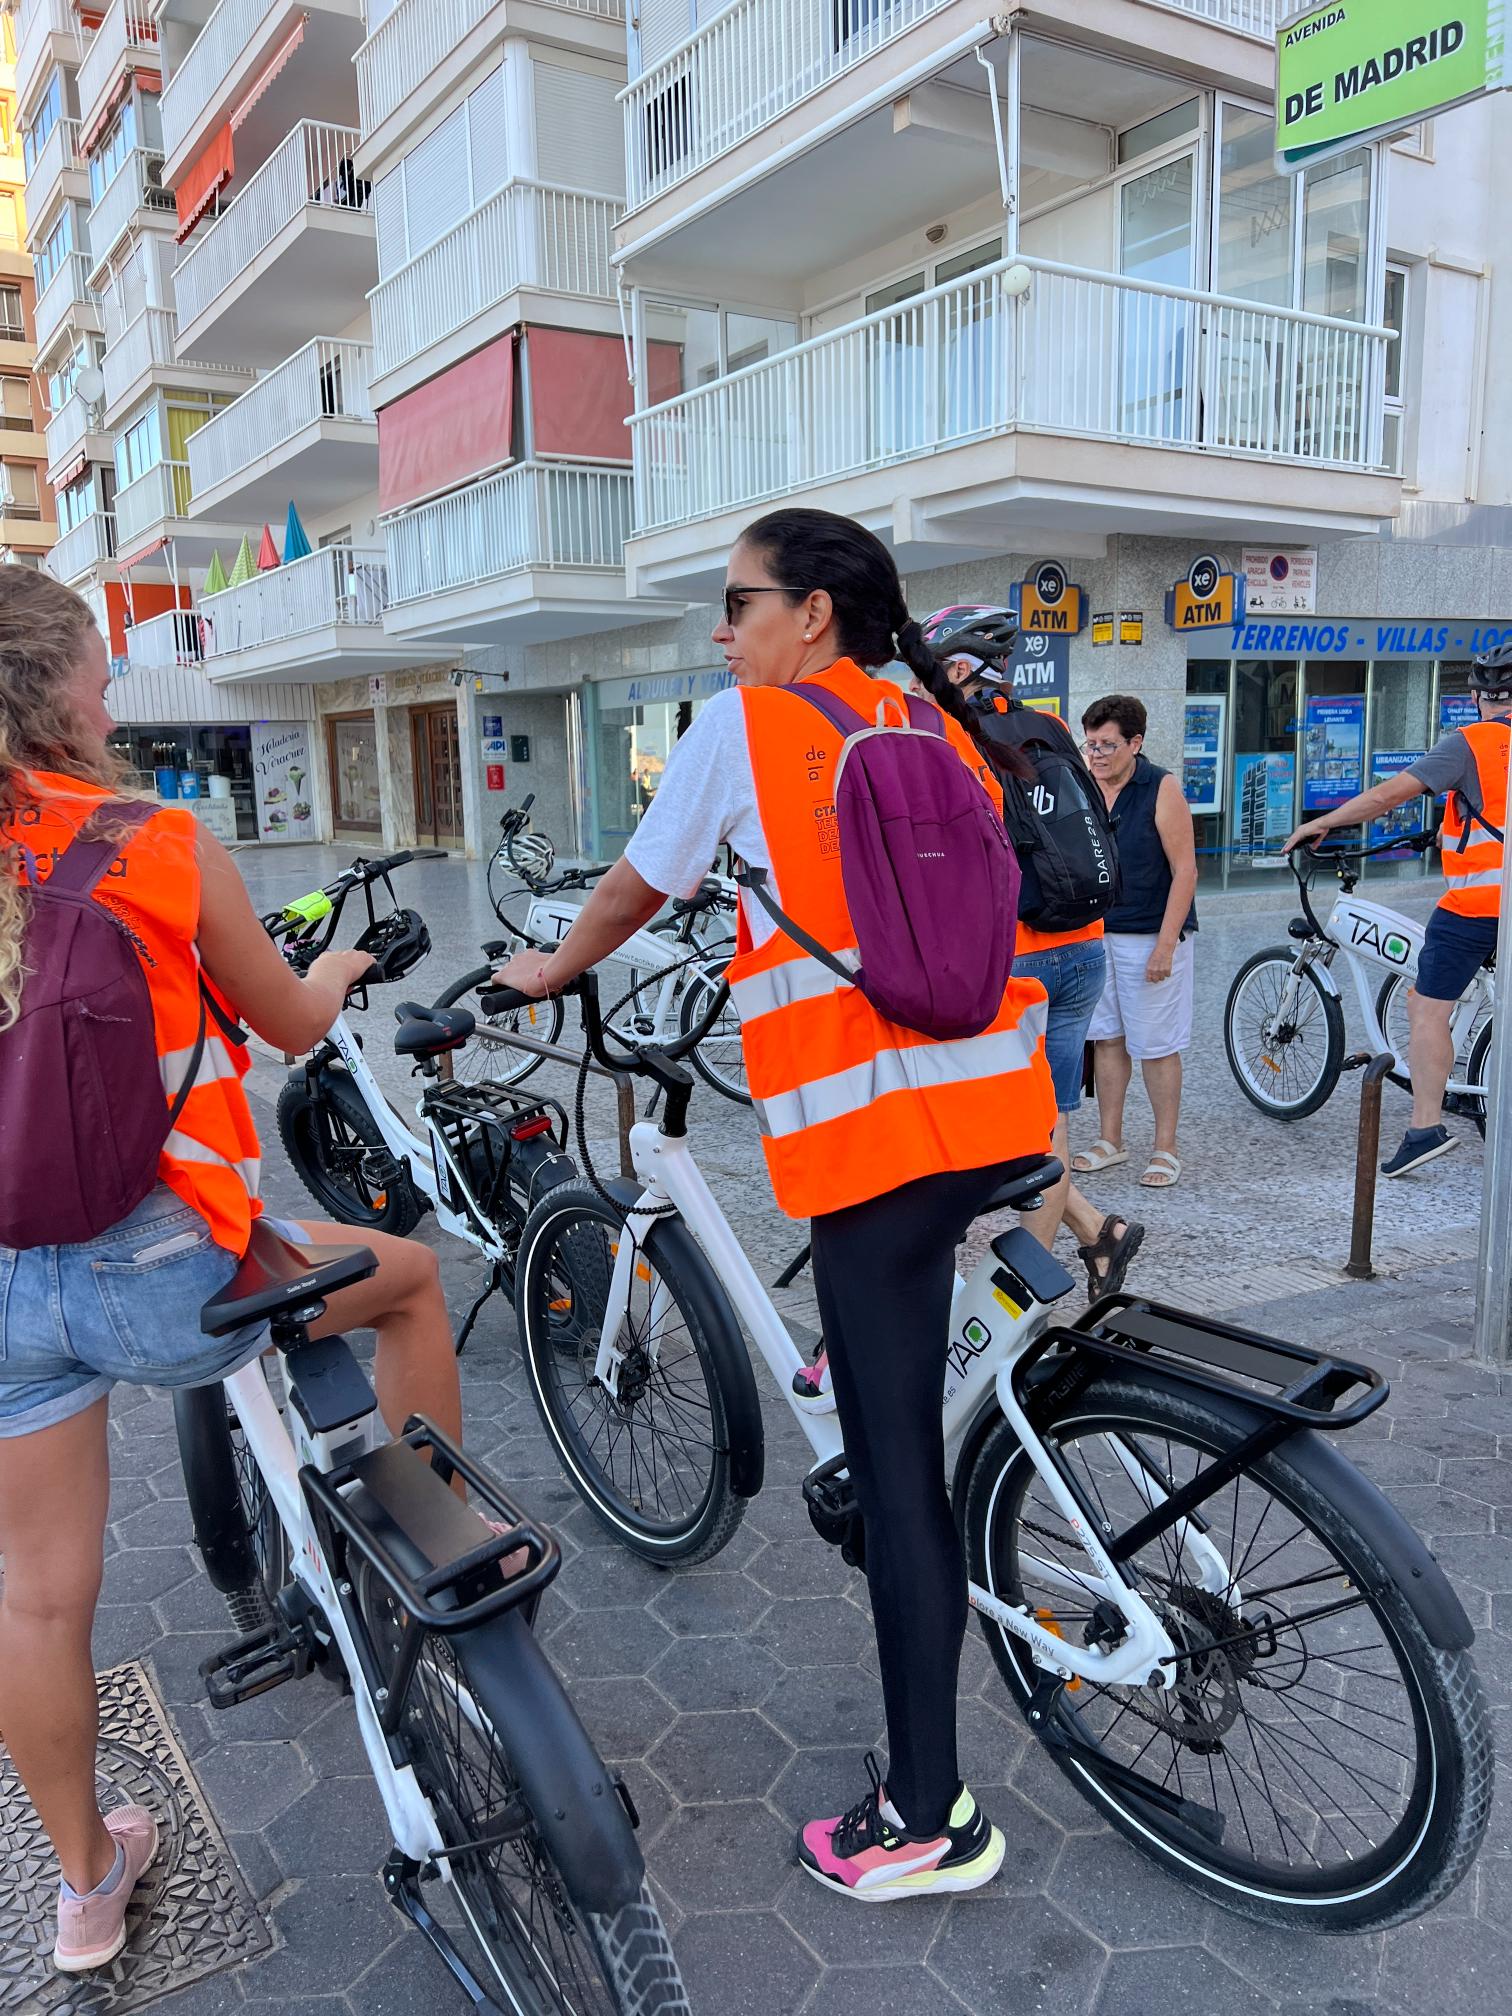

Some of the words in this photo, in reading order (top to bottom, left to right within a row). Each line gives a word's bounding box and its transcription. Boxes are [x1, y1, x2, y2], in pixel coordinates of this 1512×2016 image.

[1285, 8, 1346, 48] AVENIDA
[1285, 82, 1323, 125] DE
[1334, 20, 1464, 103] MADRID
[1030, 610, 1067, 629] ATM
[1183, 602, 1222, 624] ATM
[1231, 624, 1350, 653] TERRENOS
[1377, 627, 1449, 653] VILLAS
[687, 675, 697, 695] Y
[1013, 661, 1055, 686] ATM
[806, 745, 826, 761] de
[1348, 912, 1411, 965] TAO
[338, 1033, 357, 1074] TAO
[969, 1596, 995, 1617] plore
[1006, 1618, 1028, 1638] New
[1031, 1633, 1055, 1656] Way
